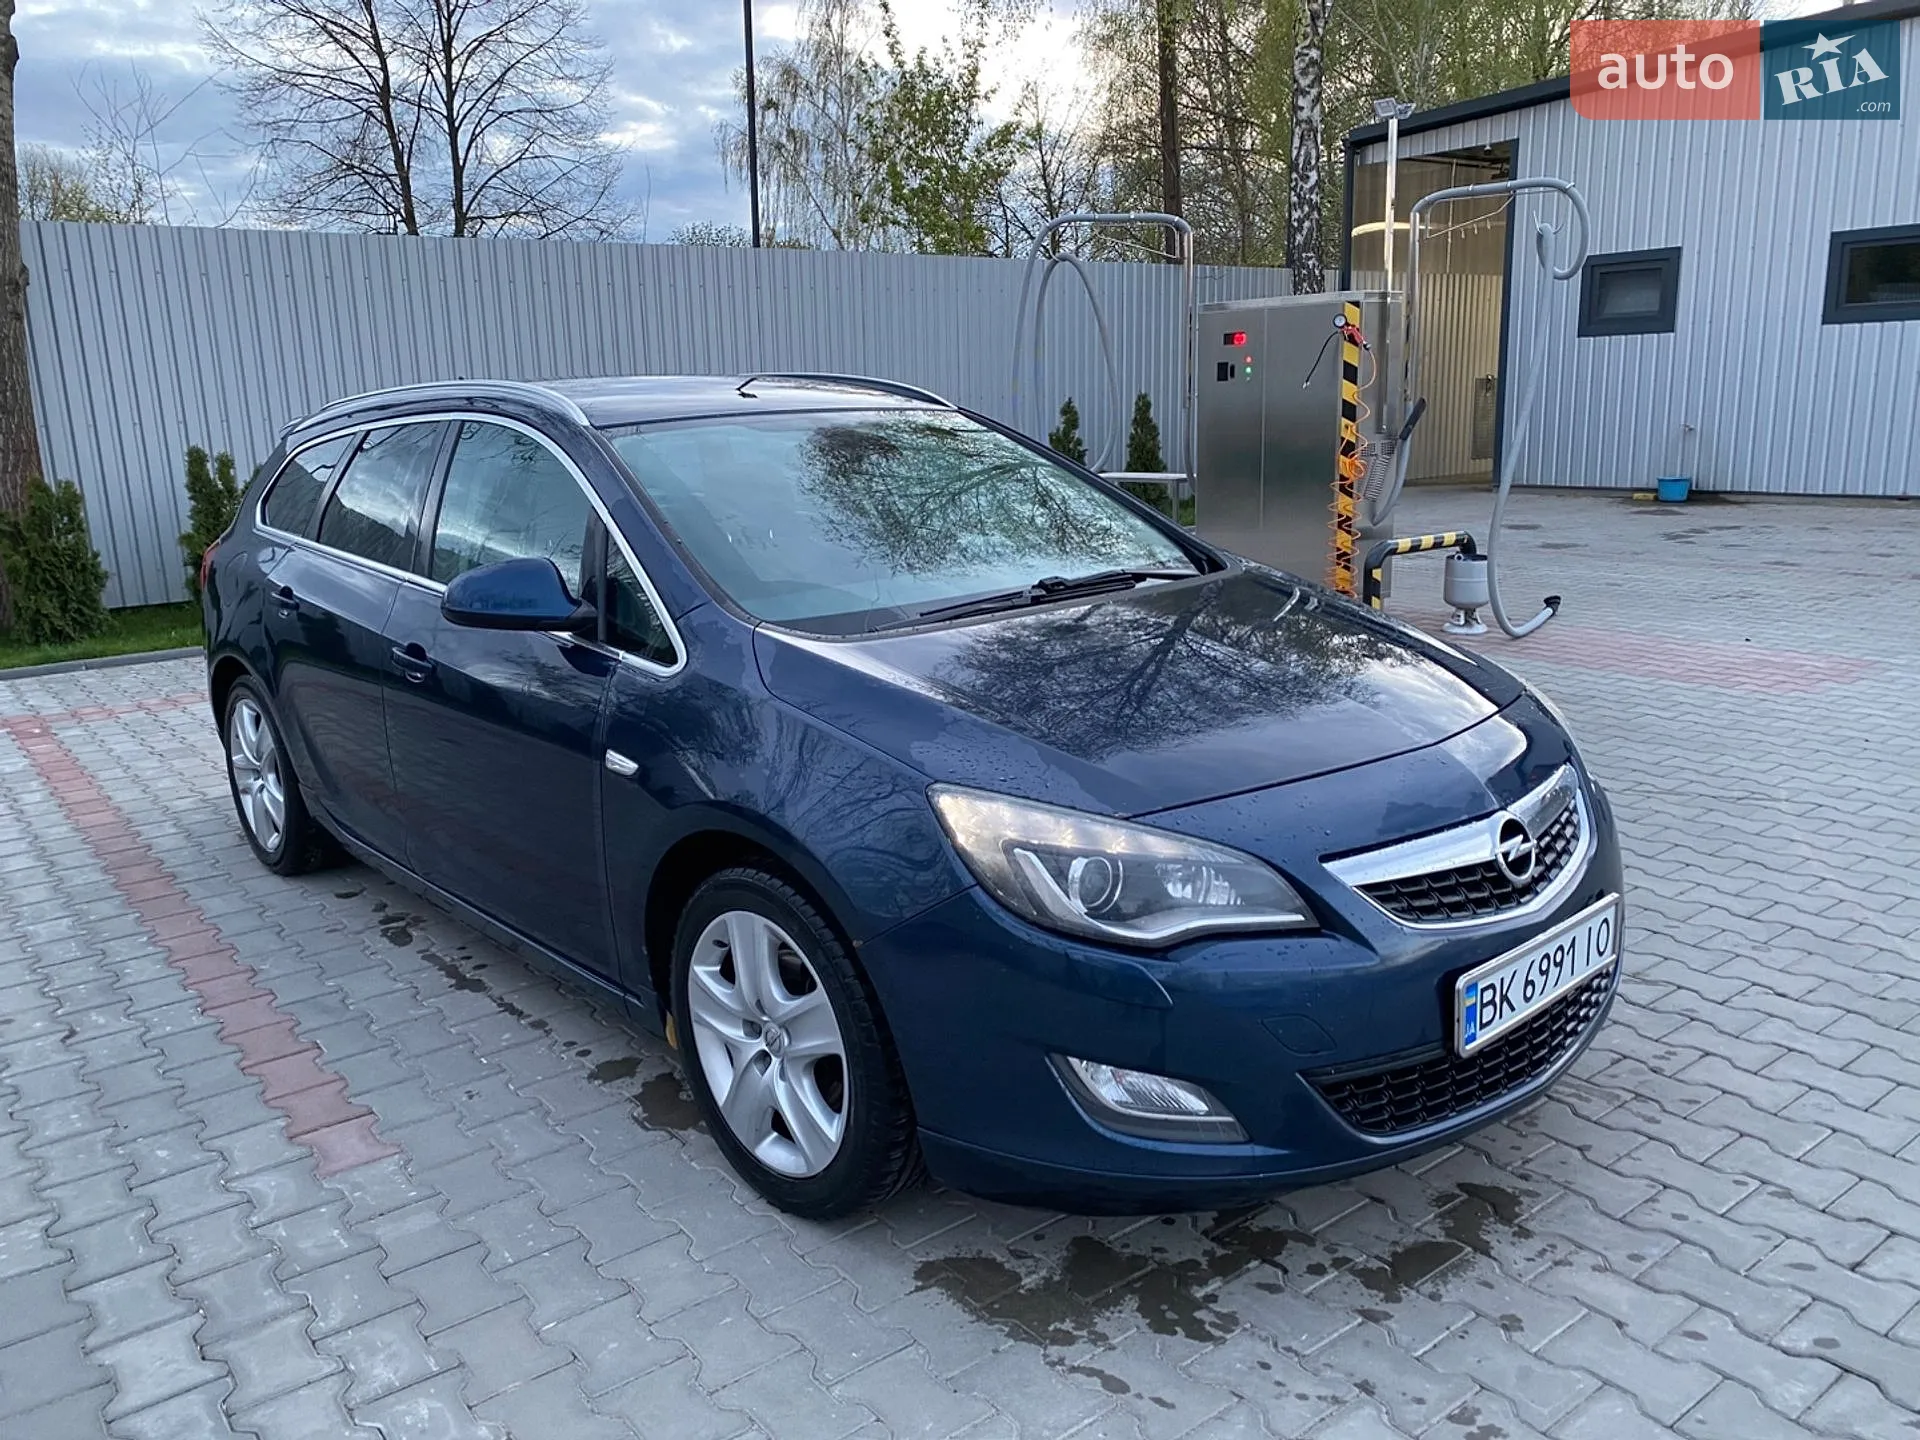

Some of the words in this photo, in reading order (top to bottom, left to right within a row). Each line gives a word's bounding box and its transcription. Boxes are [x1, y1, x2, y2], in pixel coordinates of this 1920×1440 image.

[1479, 969, 1518, 1031] BK
[1522, 935, 1577, 1004] 6991
[1586, 917, 1610, 967] IO
